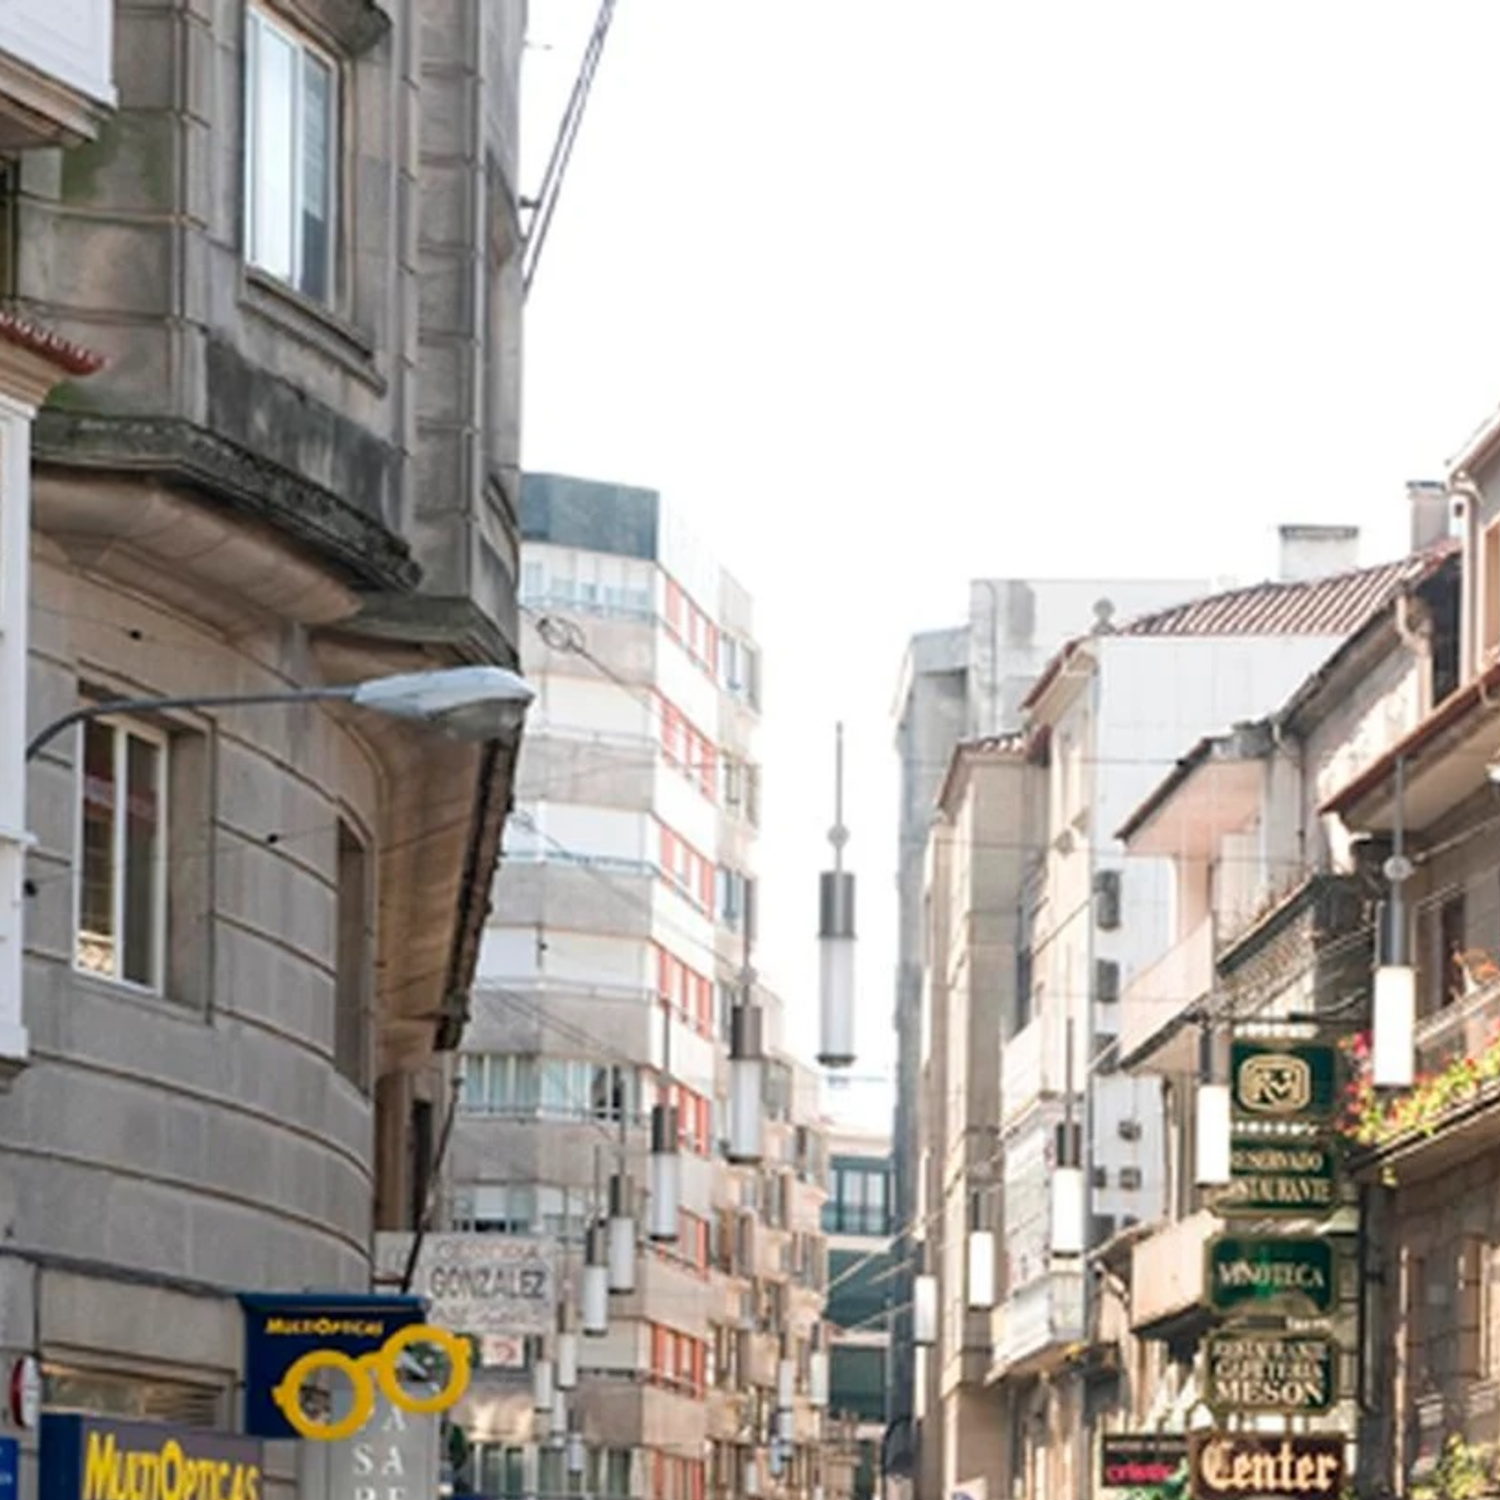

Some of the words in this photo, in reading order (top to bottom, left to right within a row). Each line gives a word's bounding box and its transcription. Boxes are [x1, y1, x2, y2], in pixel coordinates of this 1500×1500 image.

[431, 1266, 546, 1299] GONZALEZ
[1215, 1380, 1325, 1405] MESON
[1202, 1439, 1338, 1491] Center
